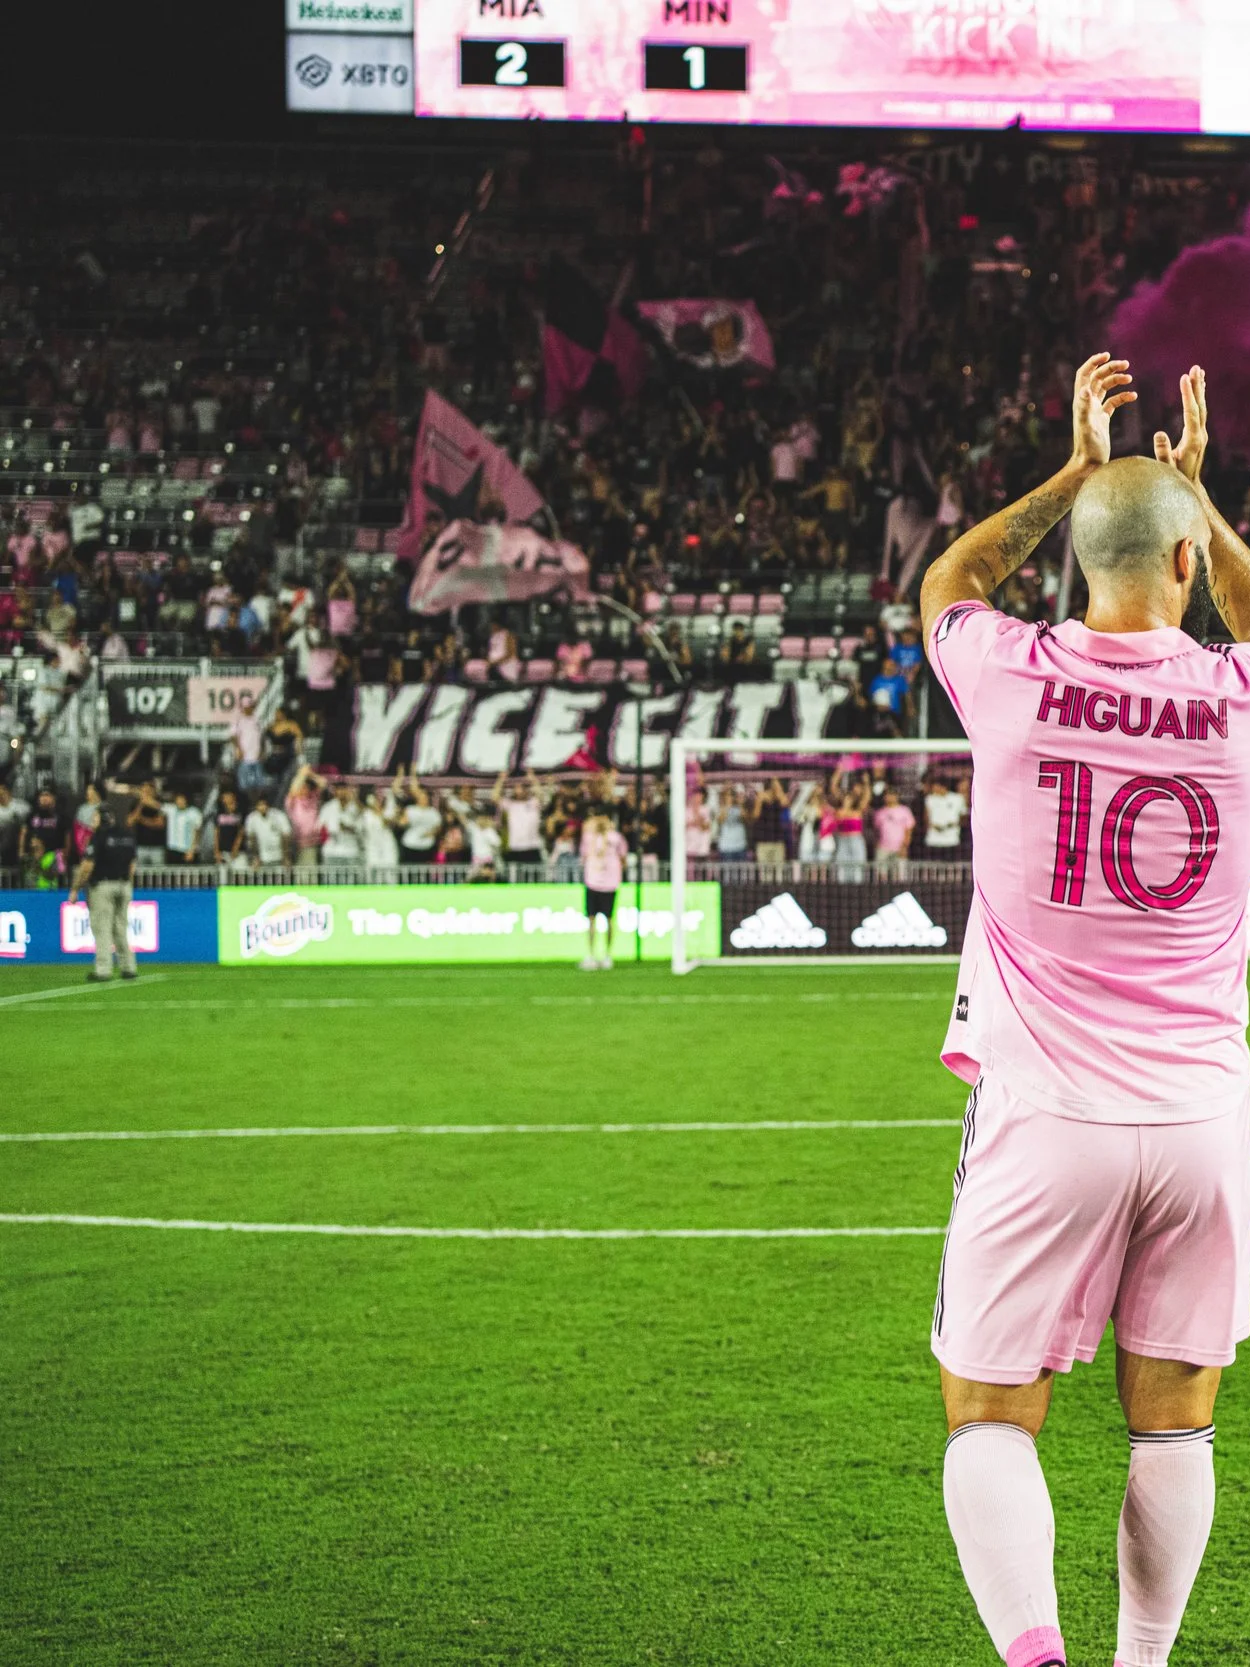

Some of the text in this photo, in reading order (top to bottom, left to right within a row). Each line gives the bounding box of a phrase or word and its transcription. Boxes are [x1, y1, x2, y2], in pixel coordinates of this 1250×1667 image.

[665, 0, 730, 23] MIN
[911, 15, 1085, 60] KICK IN
[342, 63, 409, 86] XBTO
[495, 42, 528, 85] 2
[683, 46, 706, 89] 1
[125, 686, 174, 715] 107
[1036, 680, 1229, 740] HIGUAIN
[353, 676, 852, 774] VICE CITY
[1037, 760, 1220, 913] 10
[245, 907, 330, 950] Bounty
[348, 907, 402, 936] The
[729, 927, 827, 948] adidas
[851, 926, 948, 947] adidas
